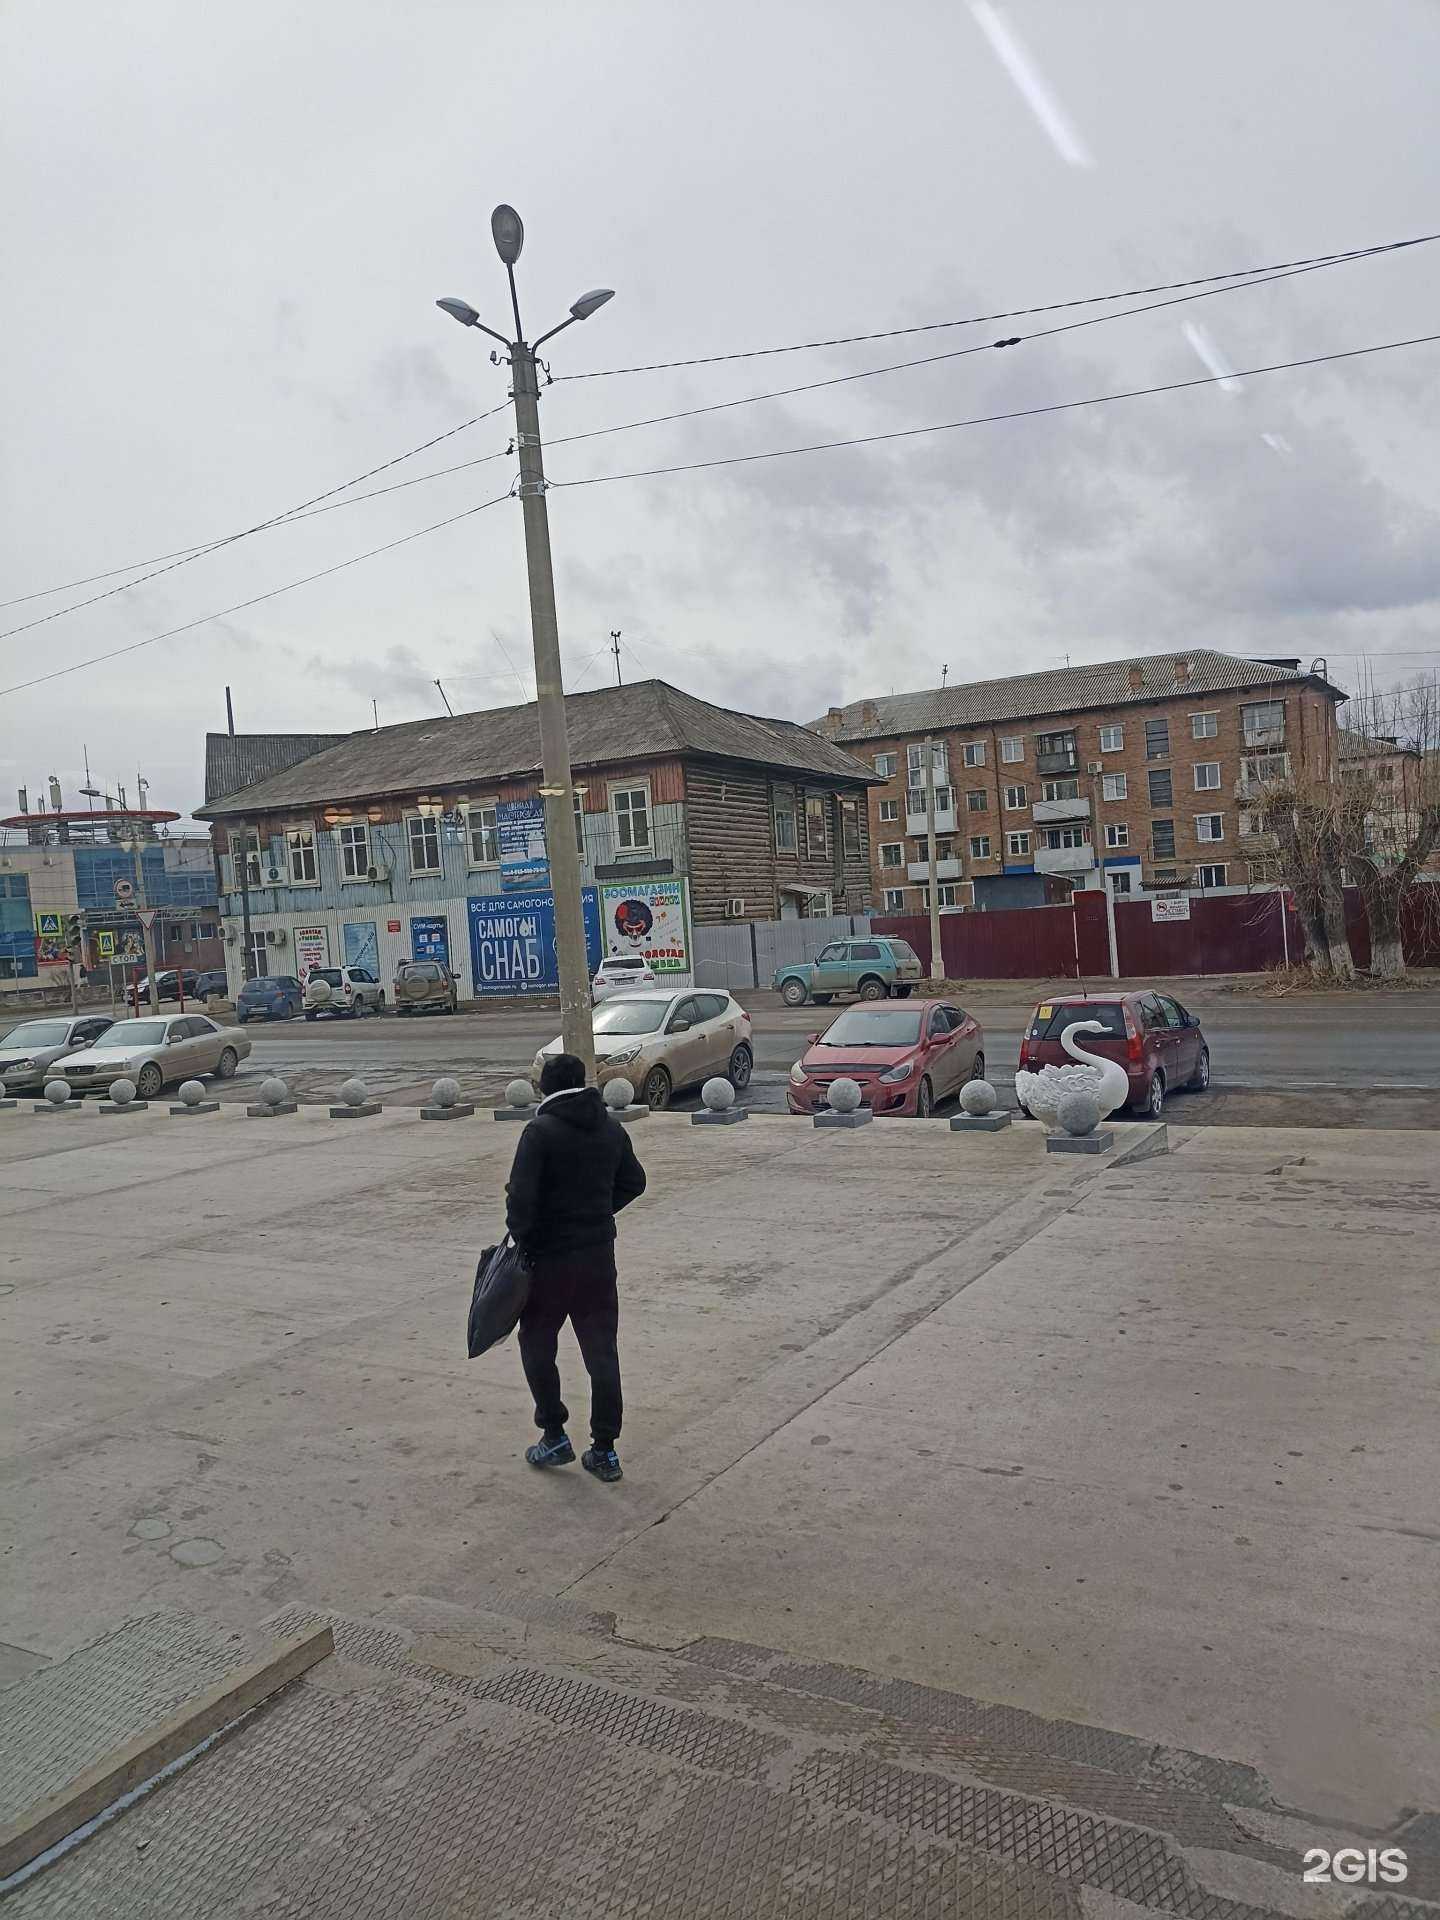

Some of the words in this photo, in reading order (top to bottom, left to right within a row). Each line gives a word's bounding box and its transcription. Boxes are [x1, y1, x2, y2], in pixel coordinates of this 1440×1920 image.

[604, 882, 680, 899] ЗООМАГАЗИН
[471, 902, 487, 912] ВСЕ
[488, 901, 505, 912] ДЛЯ
[112, 955, 135, 963] СТОП
[481, 938, 540, 980] СНАБ
